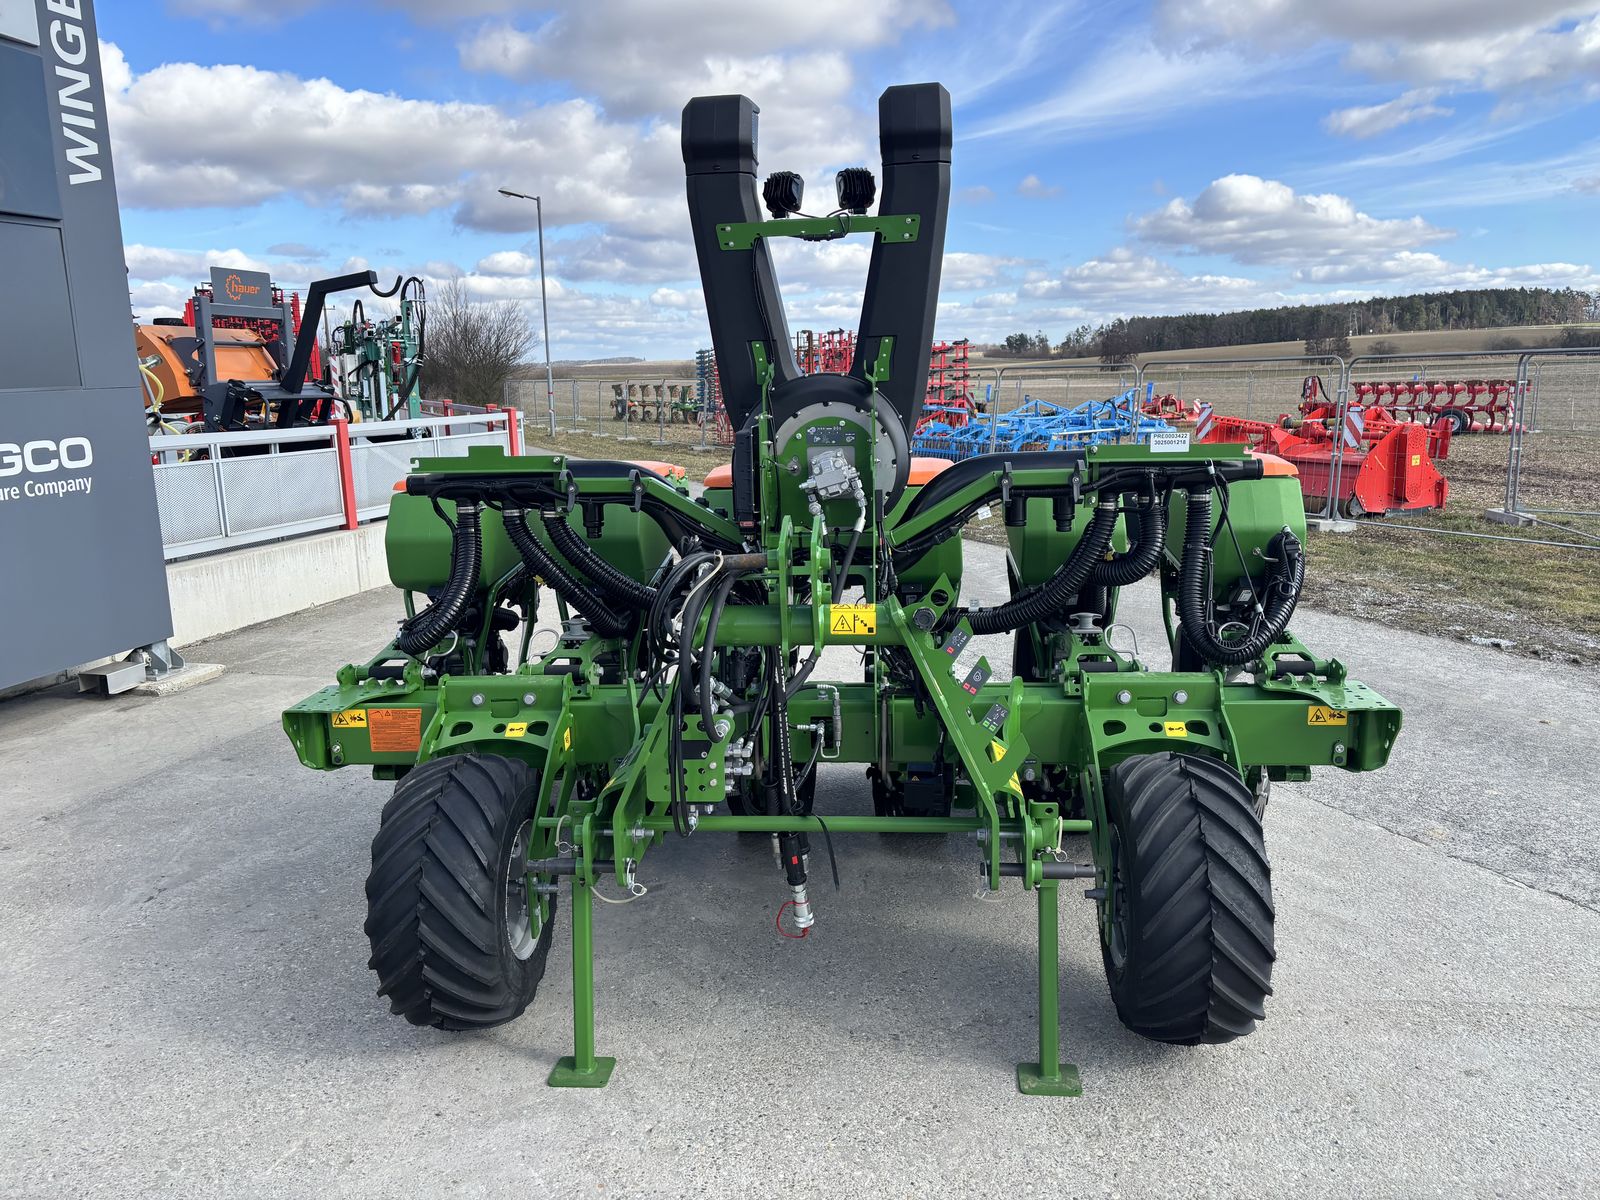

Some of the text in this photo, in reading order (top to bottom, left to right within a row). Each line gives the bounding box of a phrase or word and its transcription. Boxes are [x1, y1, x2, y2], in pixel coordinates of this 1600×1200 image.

[231, 280, 261, 295] hauer
[0, 437, 93, 477] GCO
[24, 477, 92, 498] Company
